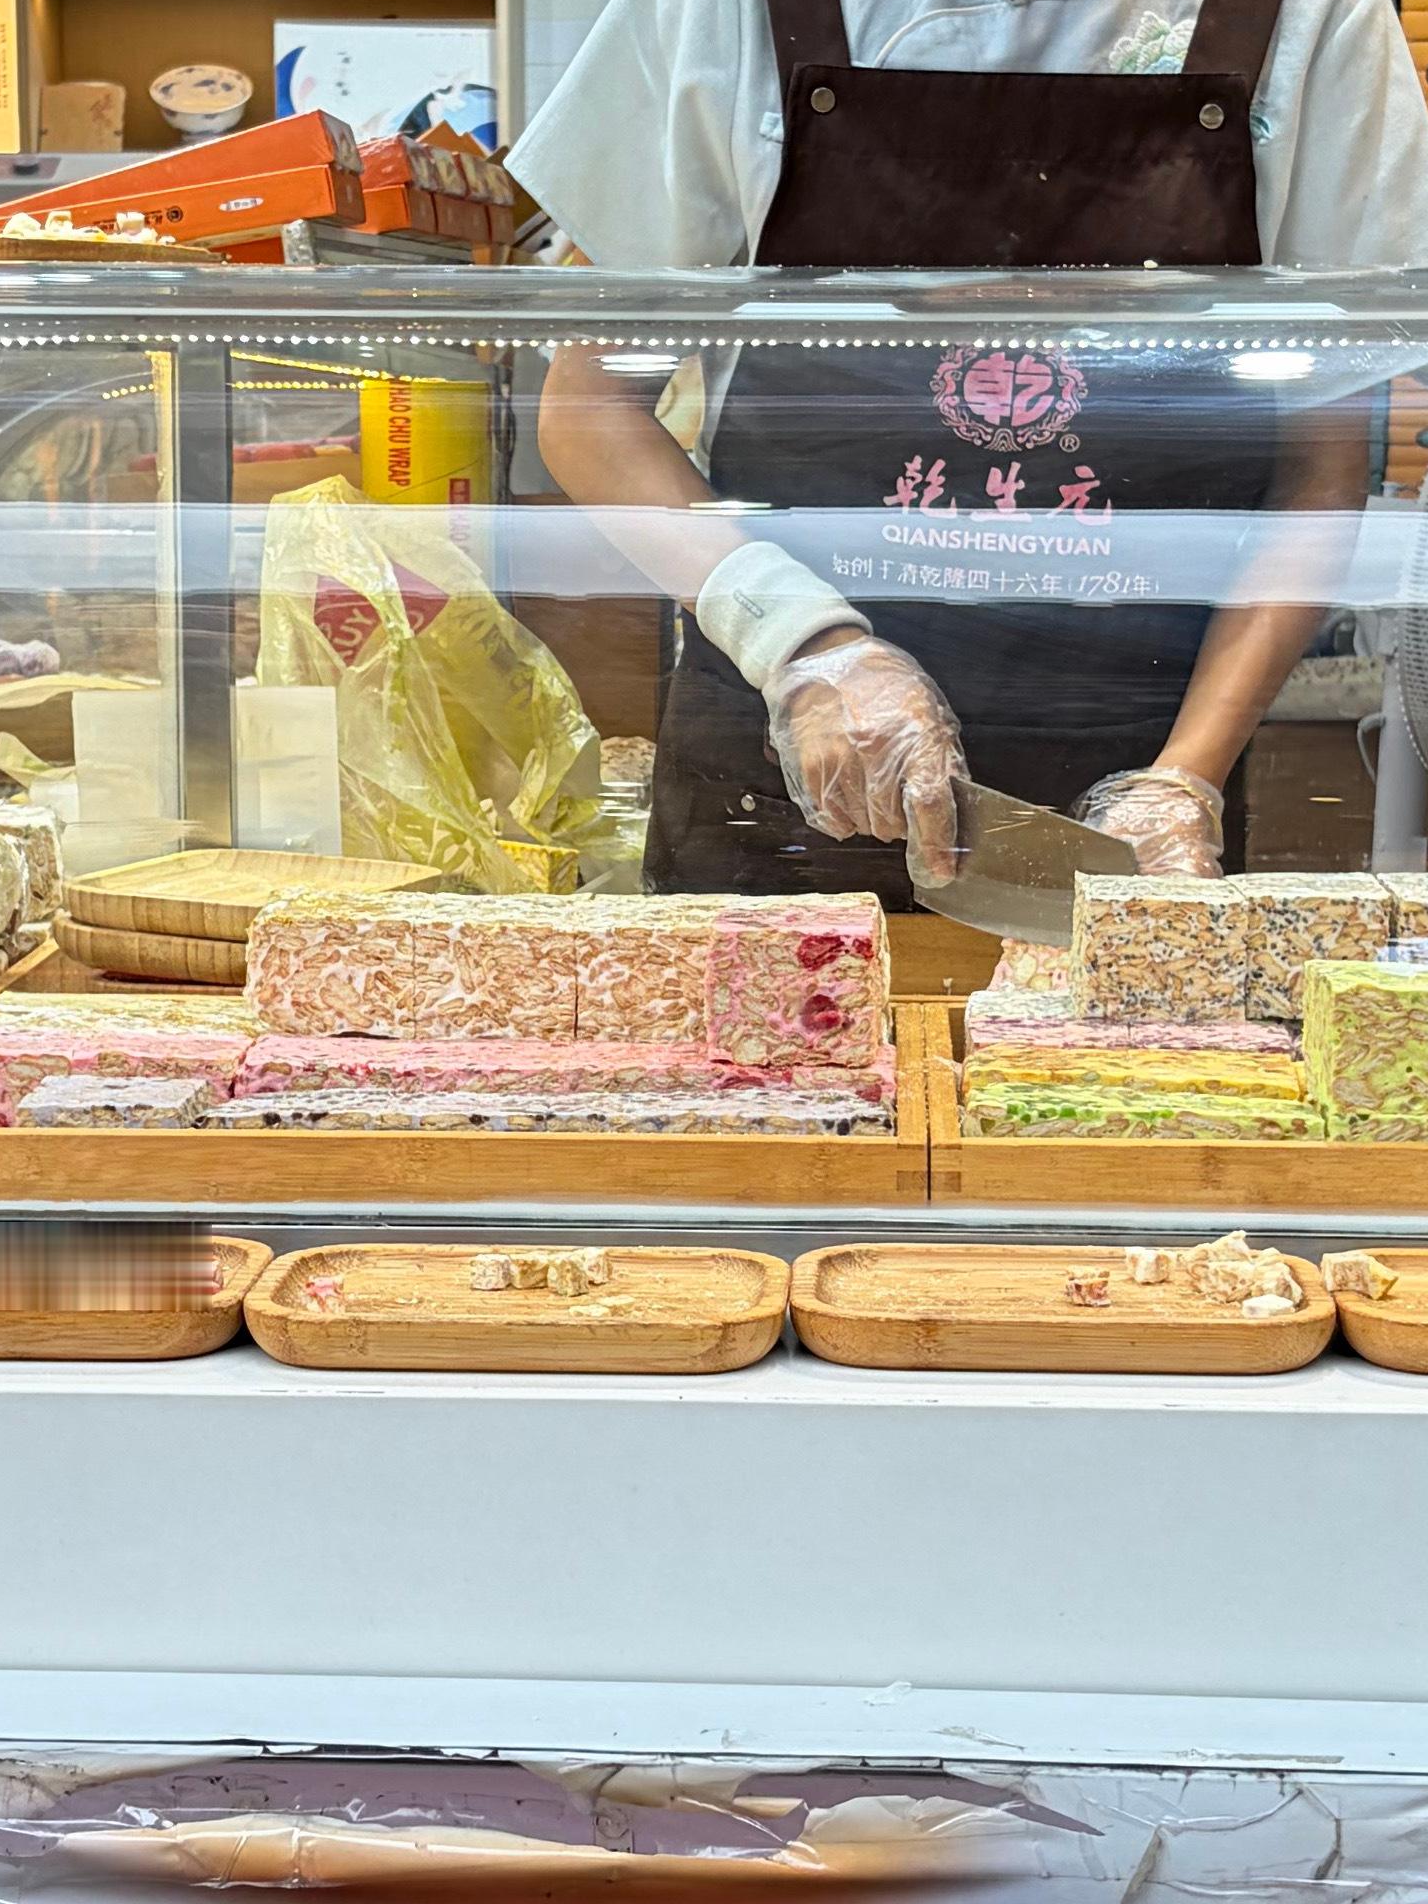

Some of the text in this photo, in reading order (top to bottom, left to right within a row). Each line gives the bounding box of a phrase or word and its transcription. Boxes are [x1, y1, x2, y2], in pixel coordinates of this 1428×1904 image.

[389, 416, 412, 444] CHU
[388, 447, 412, 487] WRAP
[883, 455, 1113, 526] 乾生元
[882, 523, 1111, 556] QIANSHENGYUAN
